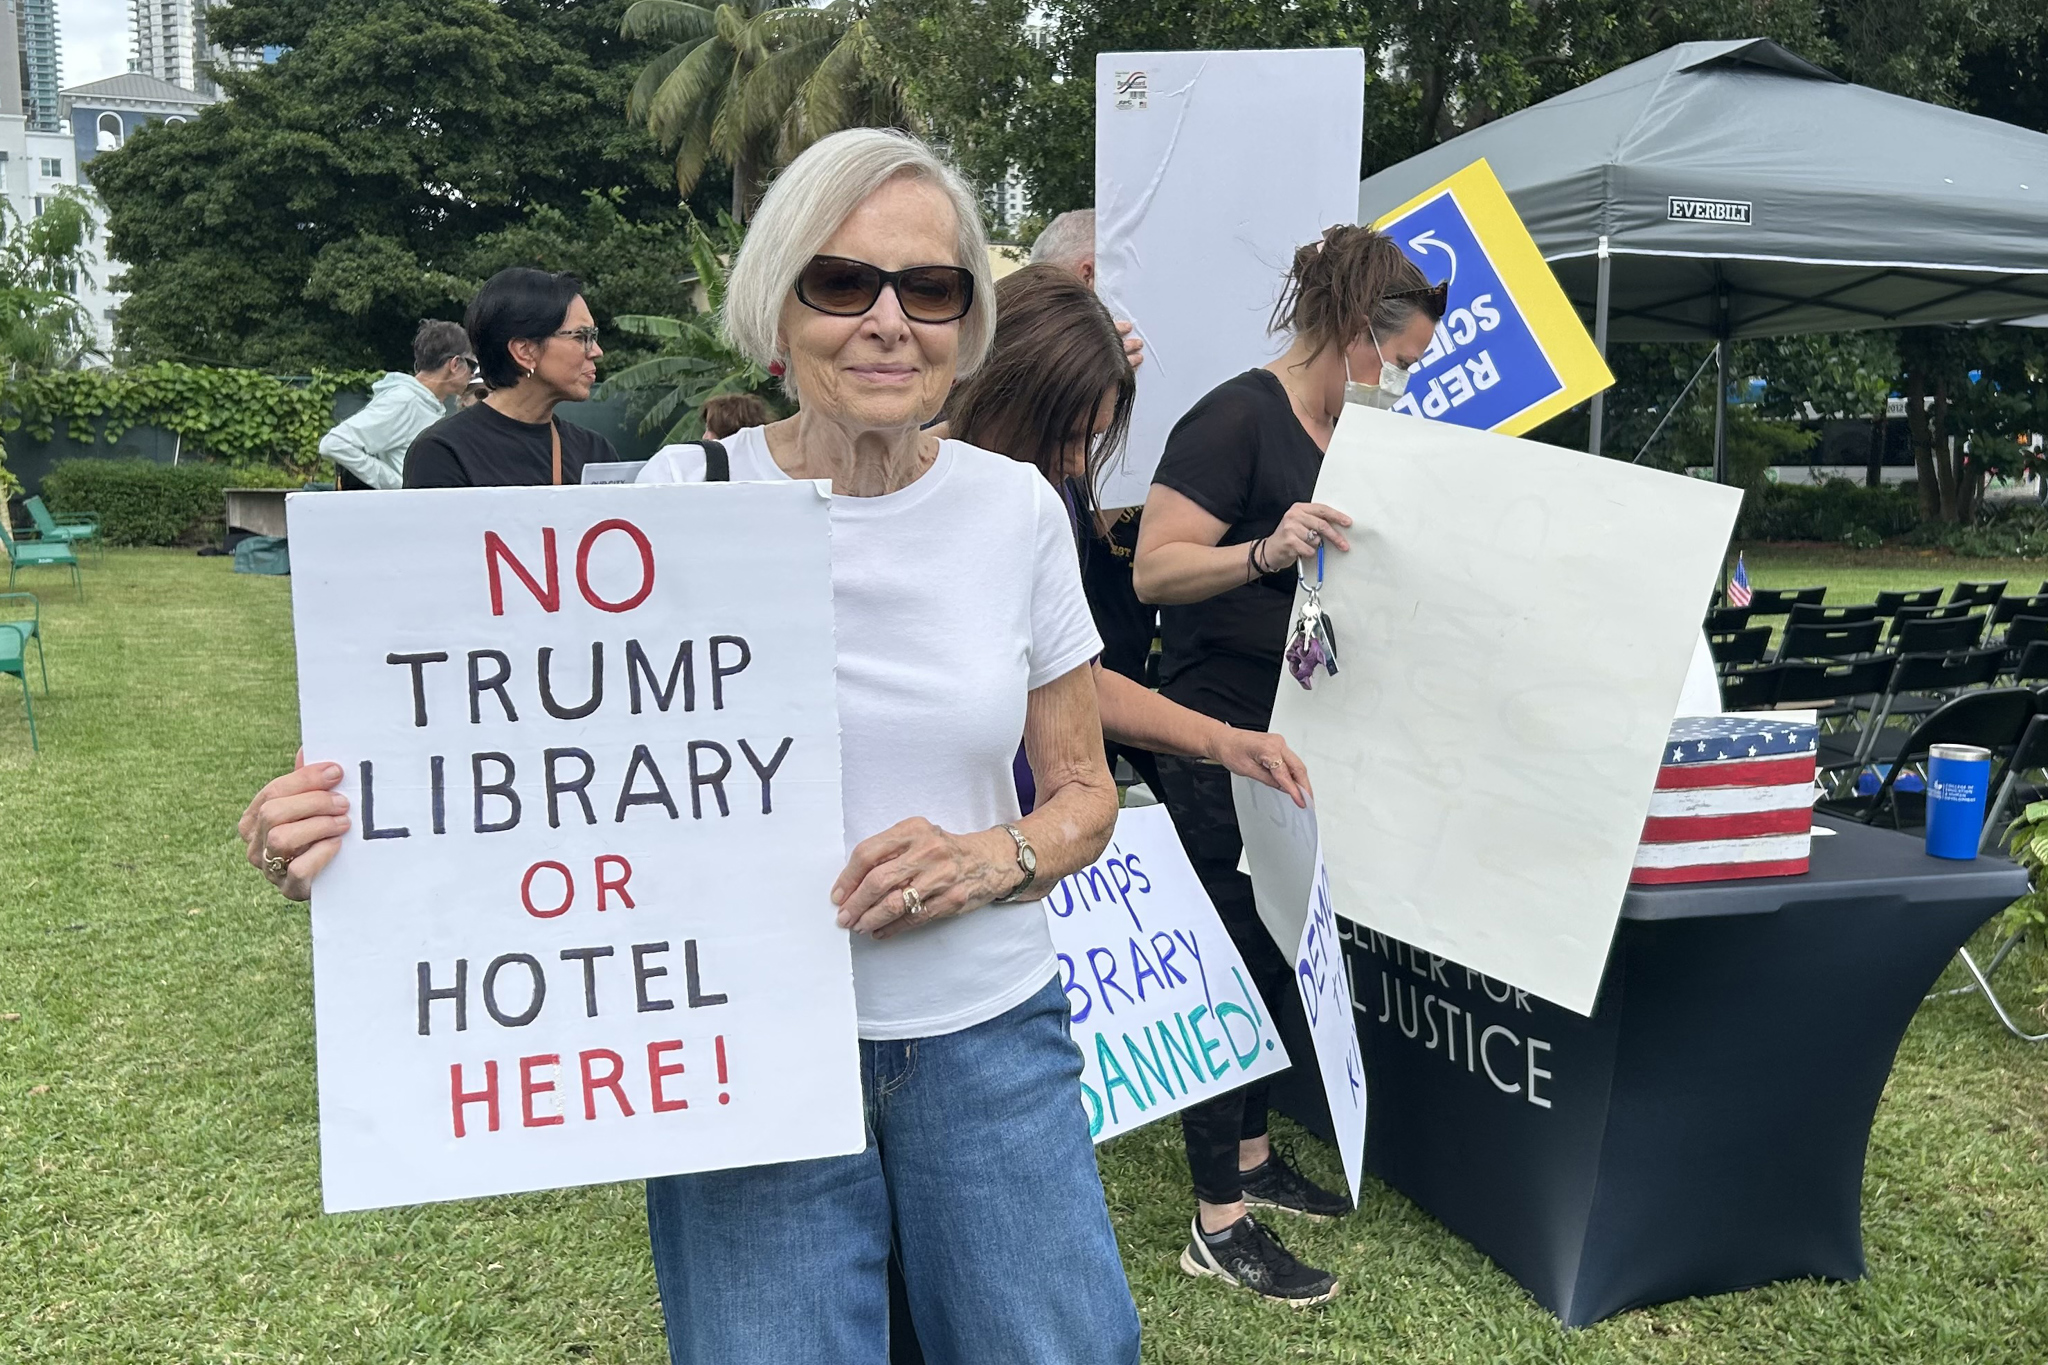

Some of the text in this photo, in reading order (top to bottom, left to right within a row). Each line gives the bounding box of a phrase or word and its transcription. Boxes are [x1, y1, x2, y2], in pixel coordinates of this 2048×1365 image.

[1672, 201, 1748, 221] EVERBILT
[1408, 293, 1501, 375] SCIE
[1390, 349, 1501, 418] REPL
[485, 518, 656, 617] NO
[387, 635, 752, 728] TRUMP
[360, 737, 794, 841] LIBRARY
[521, 855, 636, 919] OR
[417, 940, 729, 1037] HOTEL
[1338, 921, 1450, 988] ENER
[1379, 970, 1552, 1109] JUSTICE
[450, 1035, 731, 1138] HERE!
